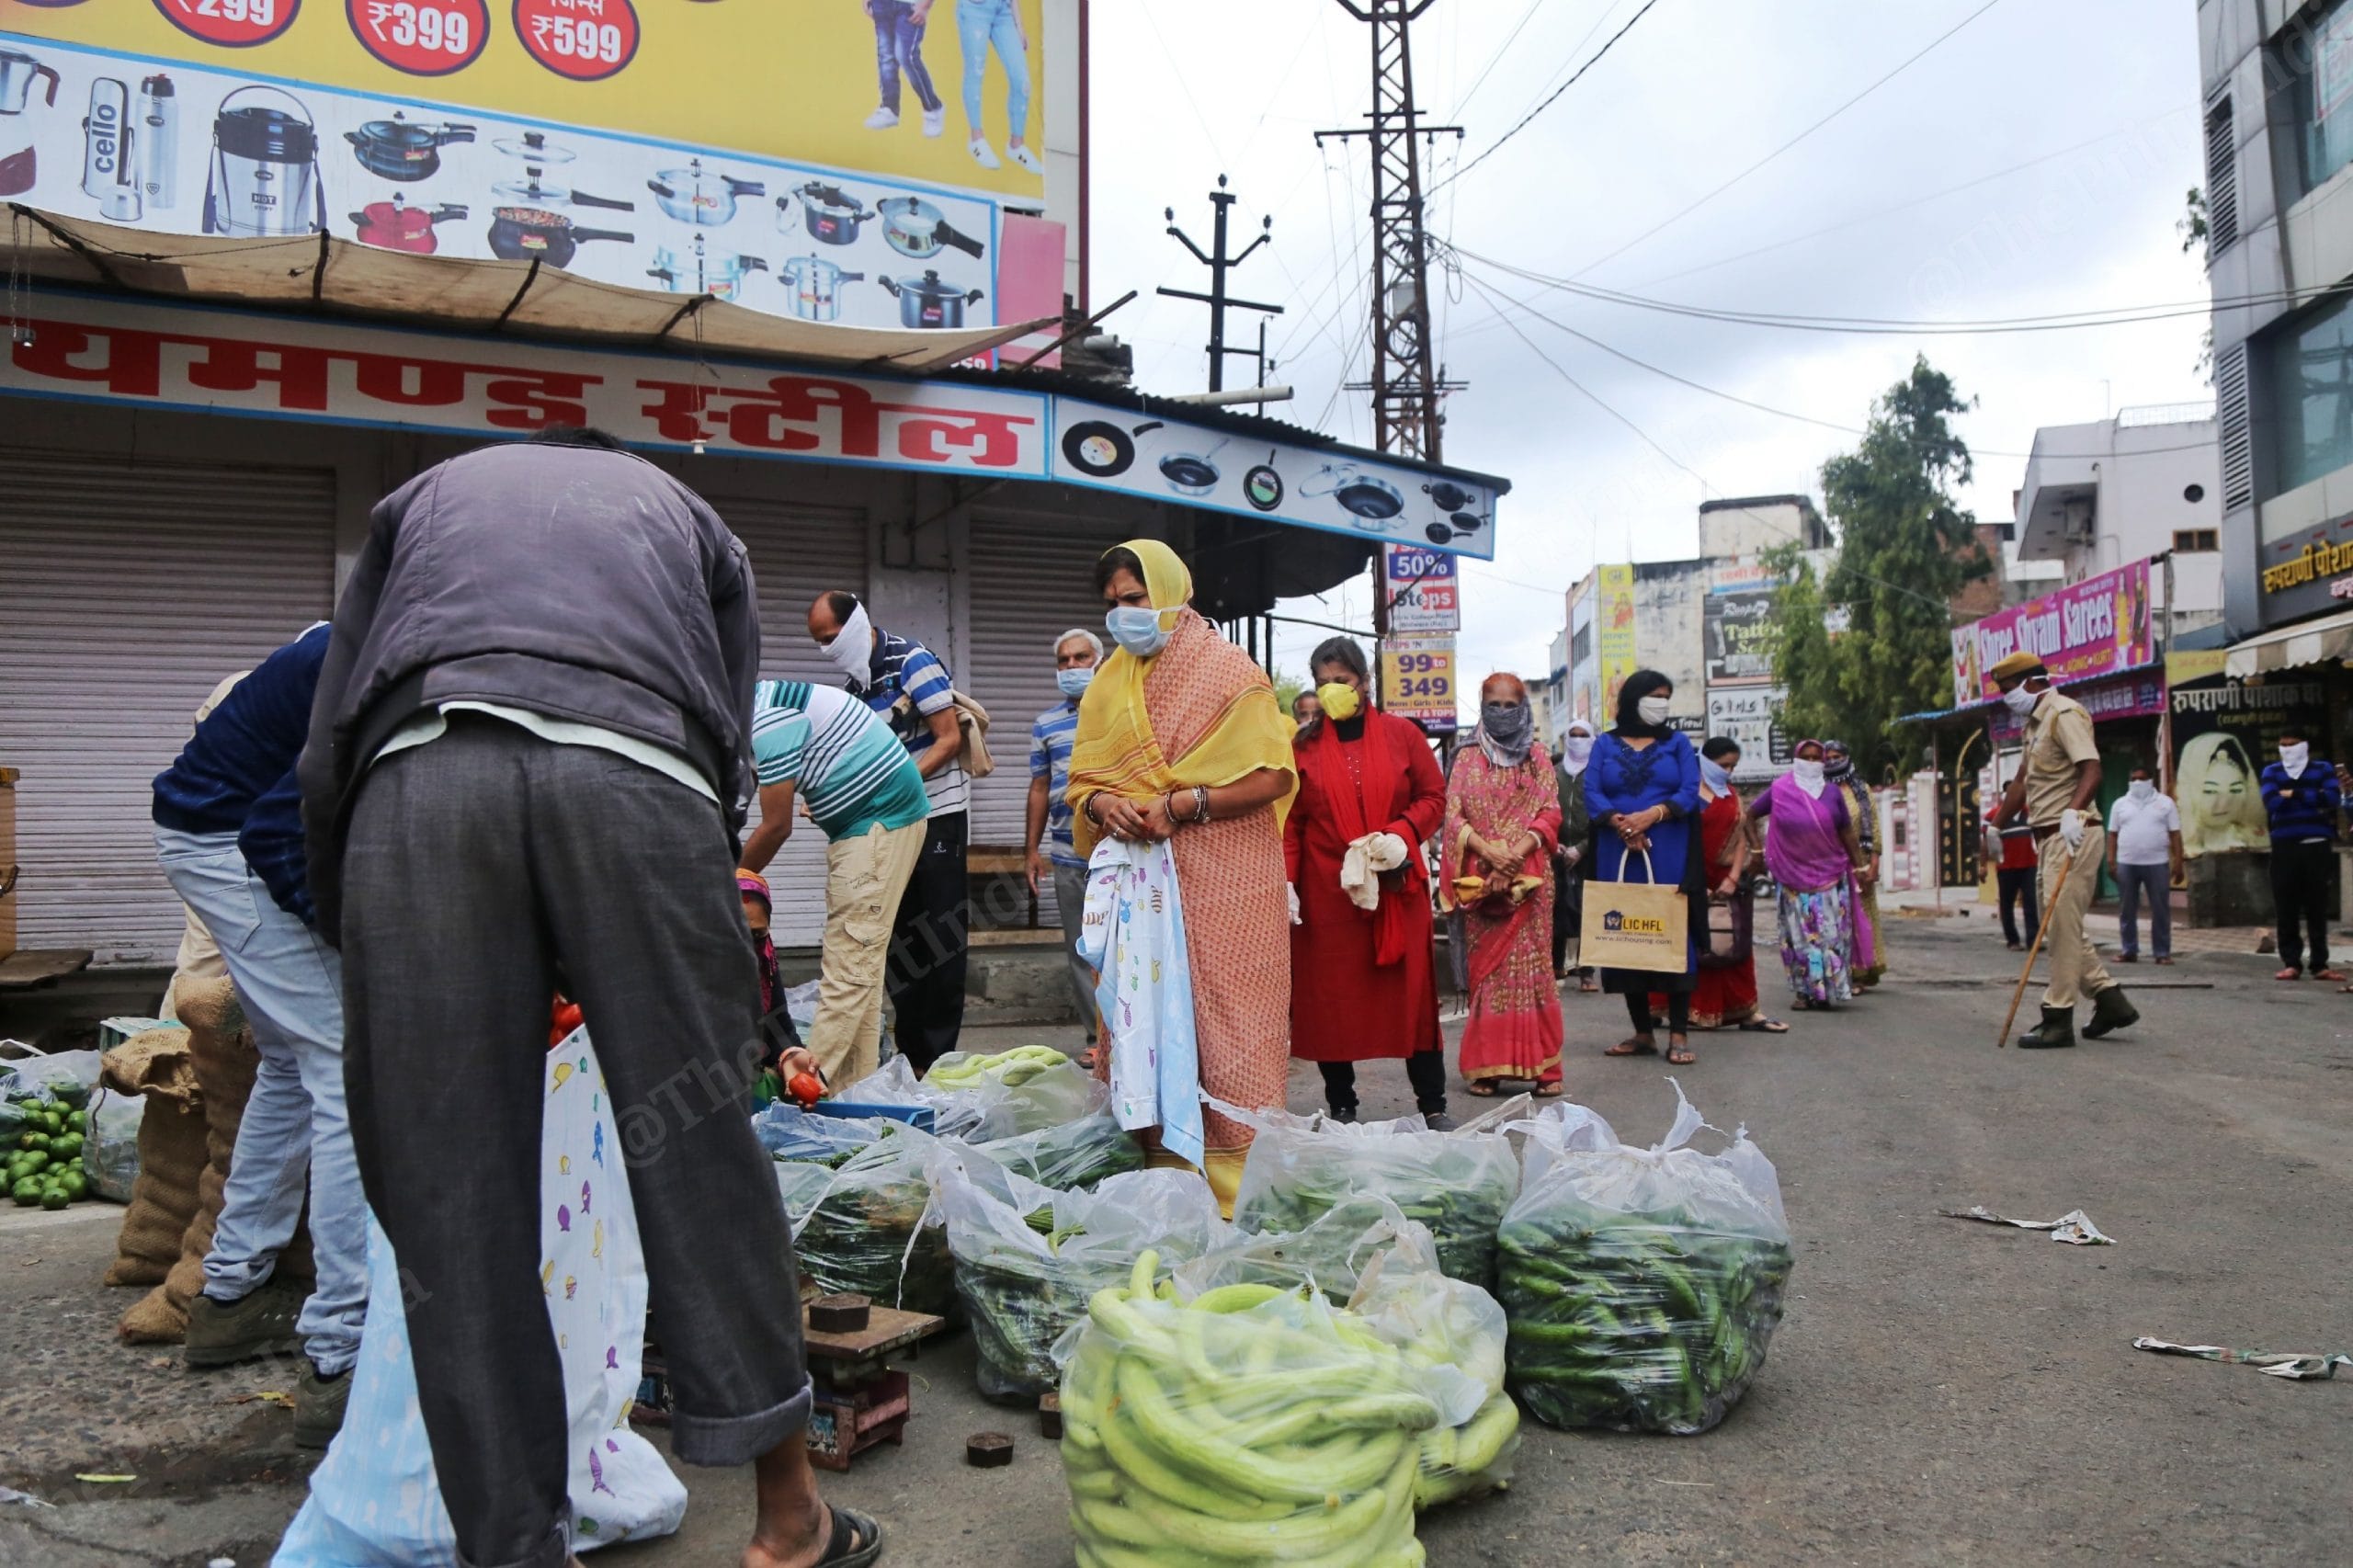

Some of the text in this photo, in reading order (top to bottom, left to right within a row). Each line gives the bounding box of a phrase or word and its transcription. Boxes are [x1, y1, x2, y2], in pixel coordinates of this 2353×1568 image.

[368, 4, 469, 54] ₹399
[531, 14, 621, 63] ₹599
[94, 103, 119, 174] cello
[636, 376, 1035, 468] स्टील
[1397, 553, 1449, 577] 50%
[1395, 589, 1452, 611] Steps
[2063, 592, 2114, 649] Sarees
[1595, 935, 1672, 945] www.lichousing.com
[1622, 918, 1663, 931] LIC HFL
